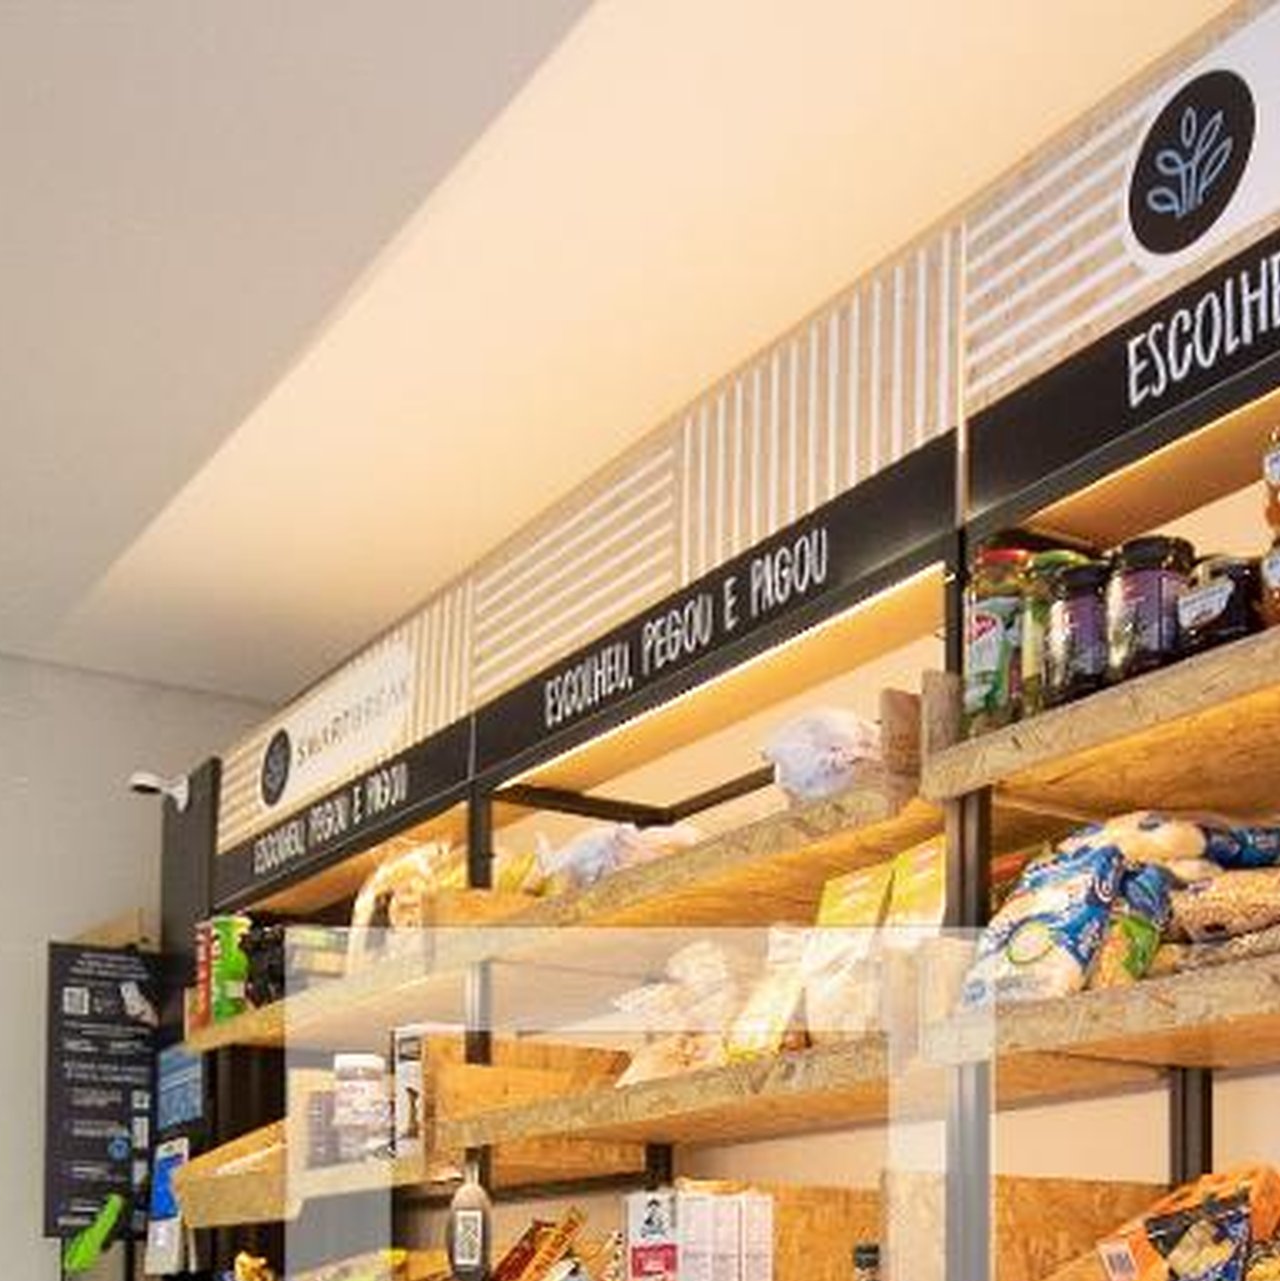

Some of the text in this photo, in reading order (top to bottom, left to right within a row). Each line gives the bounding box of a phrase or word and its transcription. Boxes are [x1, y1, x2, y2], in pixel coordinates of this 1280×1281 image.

[545, 527, 829, 728] ESCOLHEU, PEGOU E PAGOU
